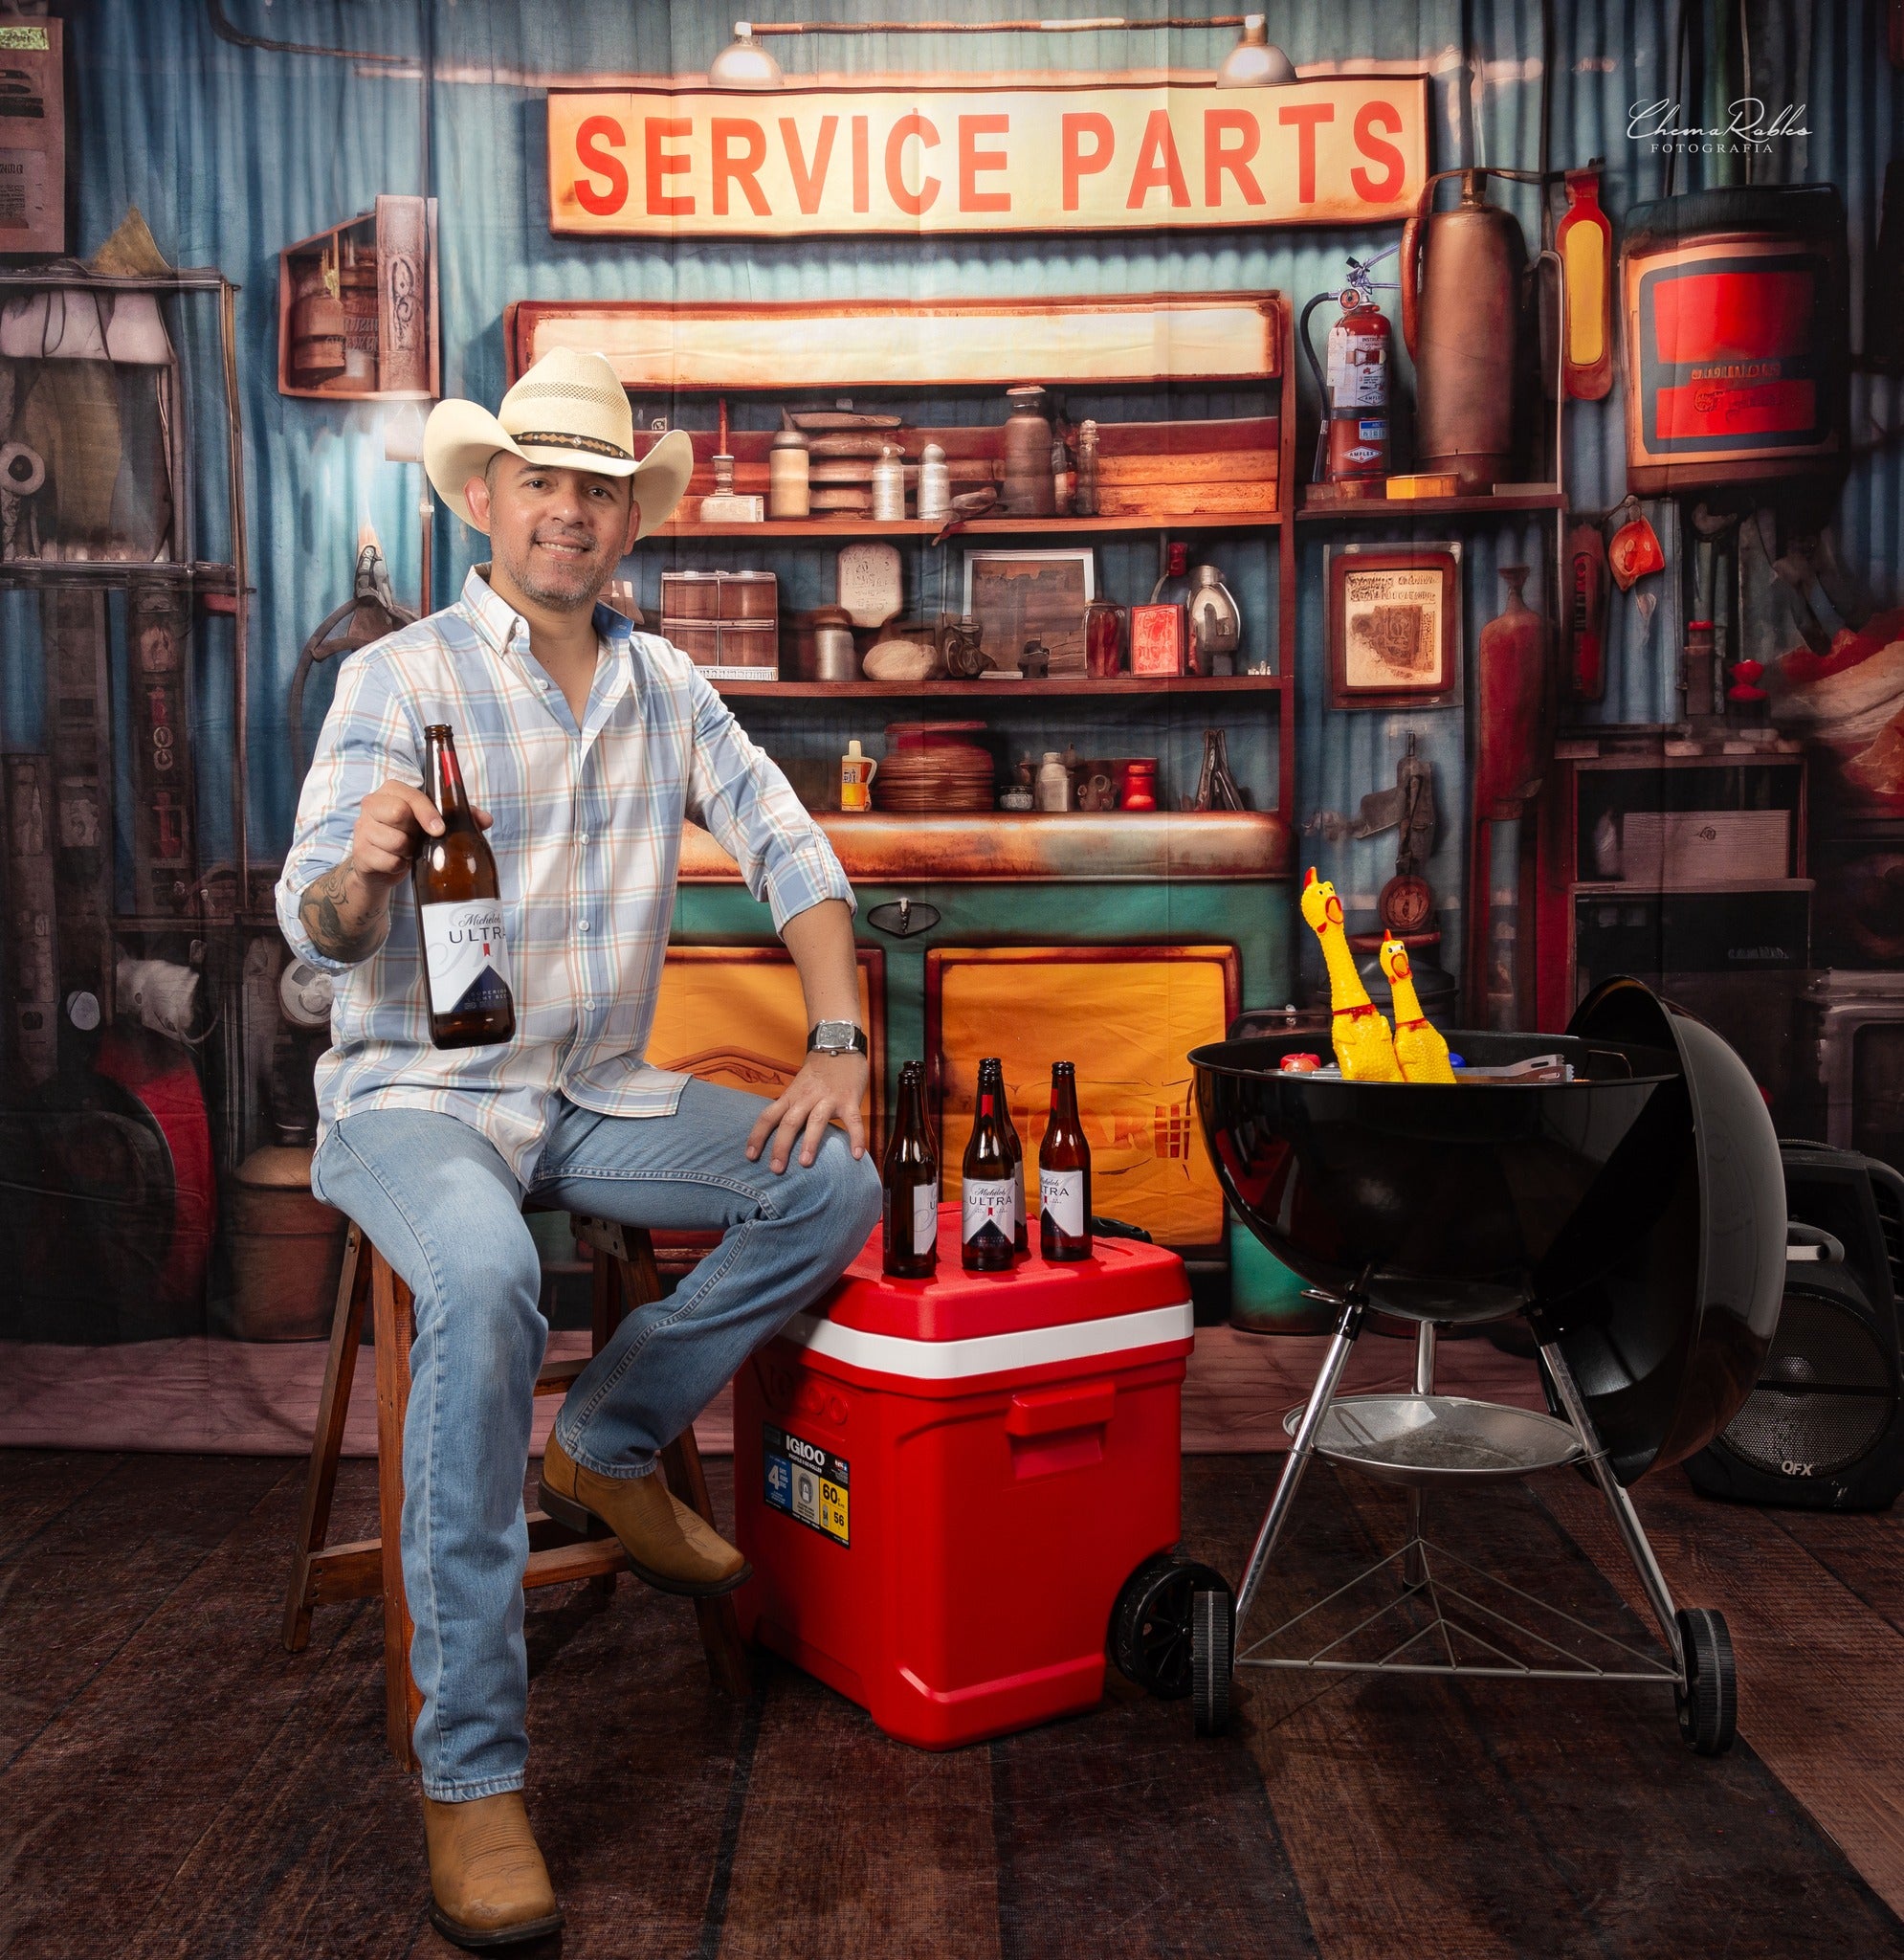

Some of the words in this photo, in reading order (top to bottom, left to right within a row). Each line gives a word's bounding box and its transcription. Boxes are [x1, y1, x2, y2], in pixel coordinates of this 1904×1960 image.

[574, 114, 1011, 216] SERVICE
[1062, 100, 1406, 212] PARTS
[969, 1195, 1012, 1206] ULTRA
[786, 1435, 826, 1466] IGLOO
[768, 1464, 780, 1490] 4
[1782, 1460, 1813, 1476] QFX
[823, 1483, 838, 1504] 60
[833, 1512, 845, 1526] 56
